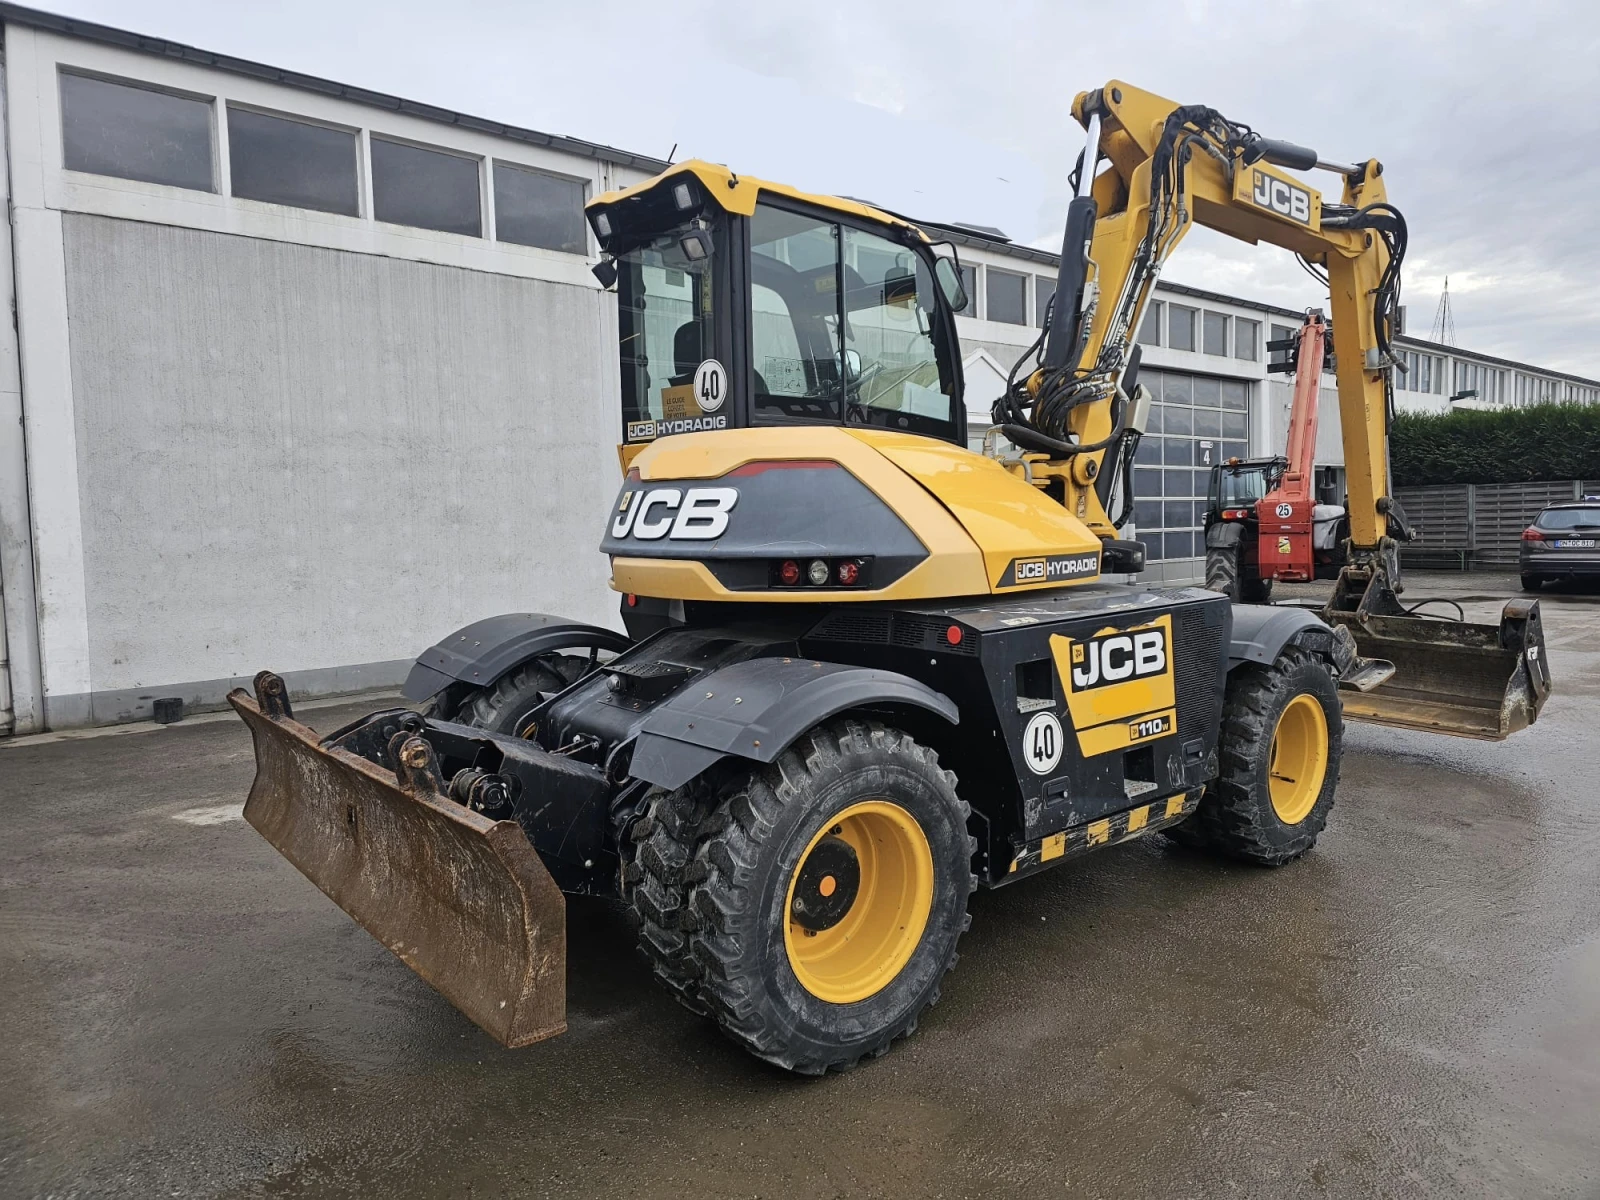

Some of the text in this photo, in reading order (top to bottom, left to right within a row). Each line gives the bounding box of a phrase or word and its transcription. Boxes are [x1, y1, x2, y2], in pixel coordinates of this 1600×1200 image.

[1254, 175, 1309, 222] JCB
[701, 369, 719, 401] 40
[630, 416, 727, 437] JCB HYDRADIG
[1203, 450, 1210, 465] 4
[612, 487, 738, 540] JCB
[1278, 505, 1290, 516] 25
[1018, 557, 1097, 579] JCB HYDRADIG
[1073, 631, 1165, 687] JCB
[1033, 724, 1055, 762] 40
